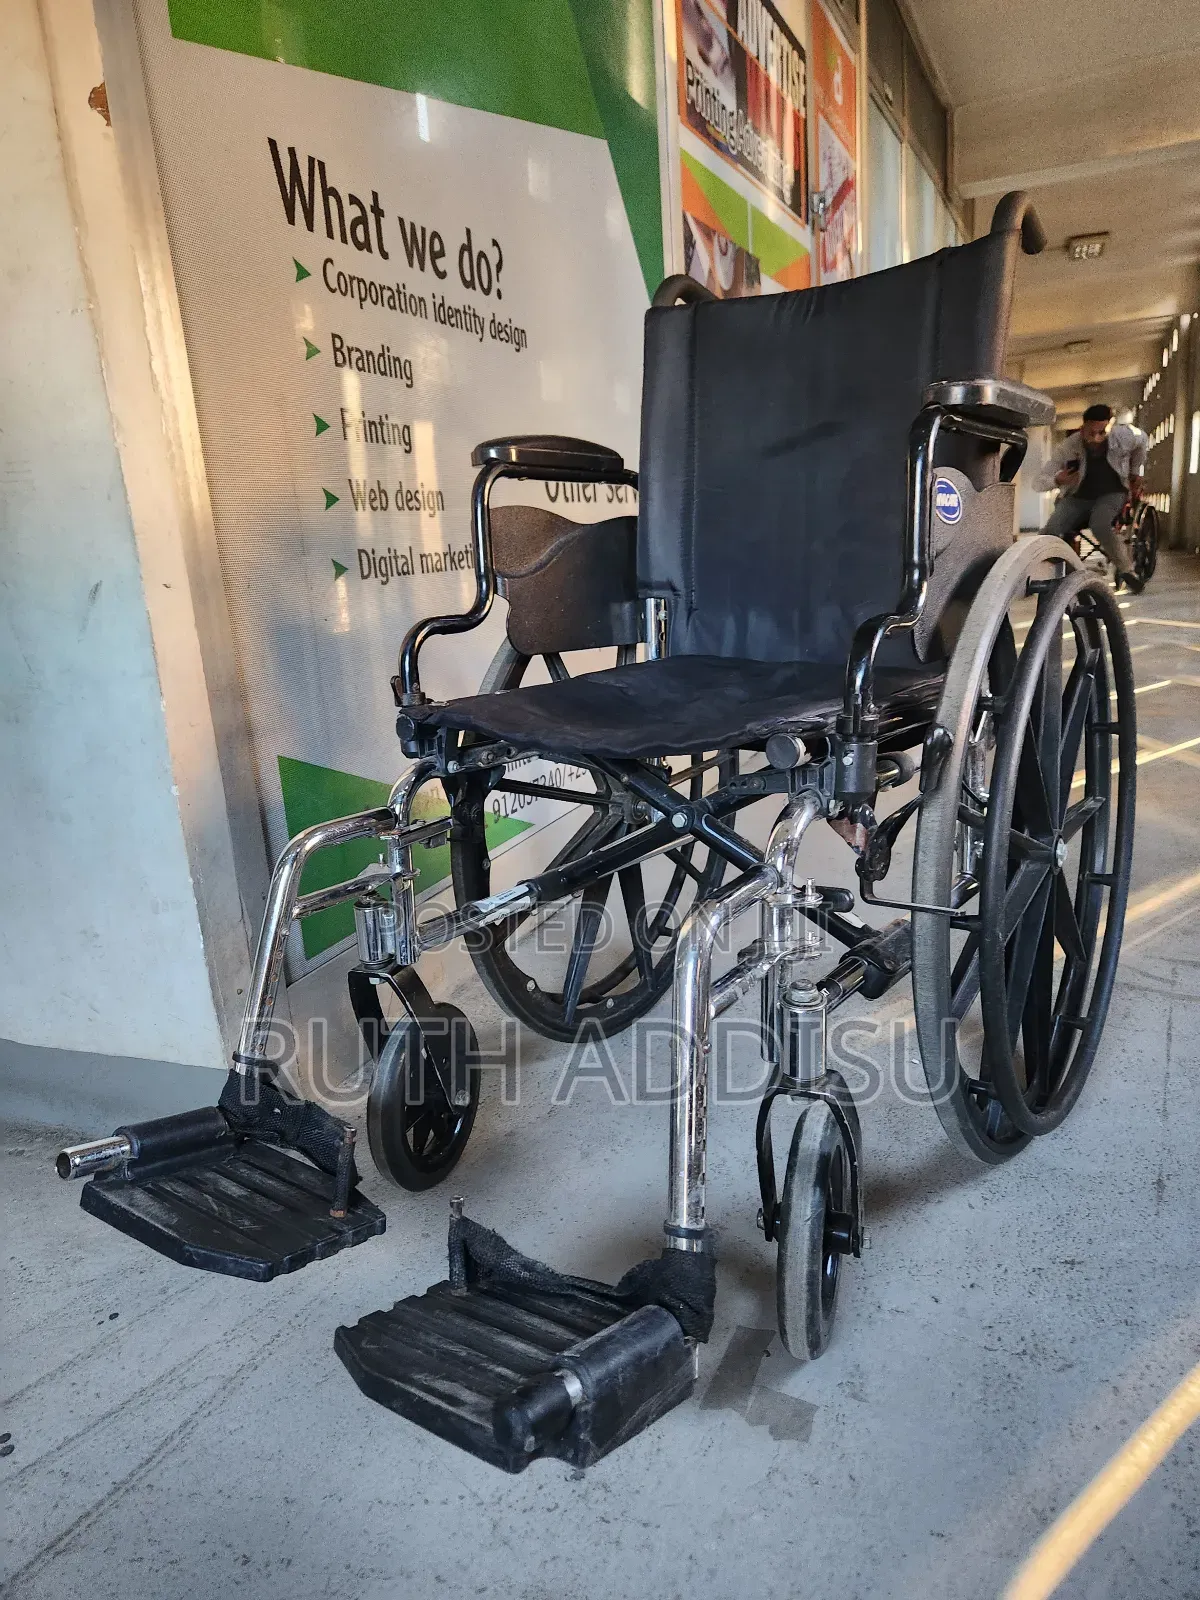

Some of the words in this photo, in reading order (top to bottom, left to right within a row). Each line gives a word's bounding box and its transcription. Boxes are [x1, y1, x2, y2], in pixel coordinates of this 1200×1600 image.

[267, 136, 390, 260] What
[397, 215, 448, 281] we
[458, 226, 503, 300] do?
[322, 257, 428, 320] Corporation
[431, 292, 485, 343] identity
[488, 312, 528, 353] design
[331, 332, 414, 389] Branding
[348, 479, 389, 512] Web
[395, 481, 445, 518] design
[357, 546, 414, 586] Digital
